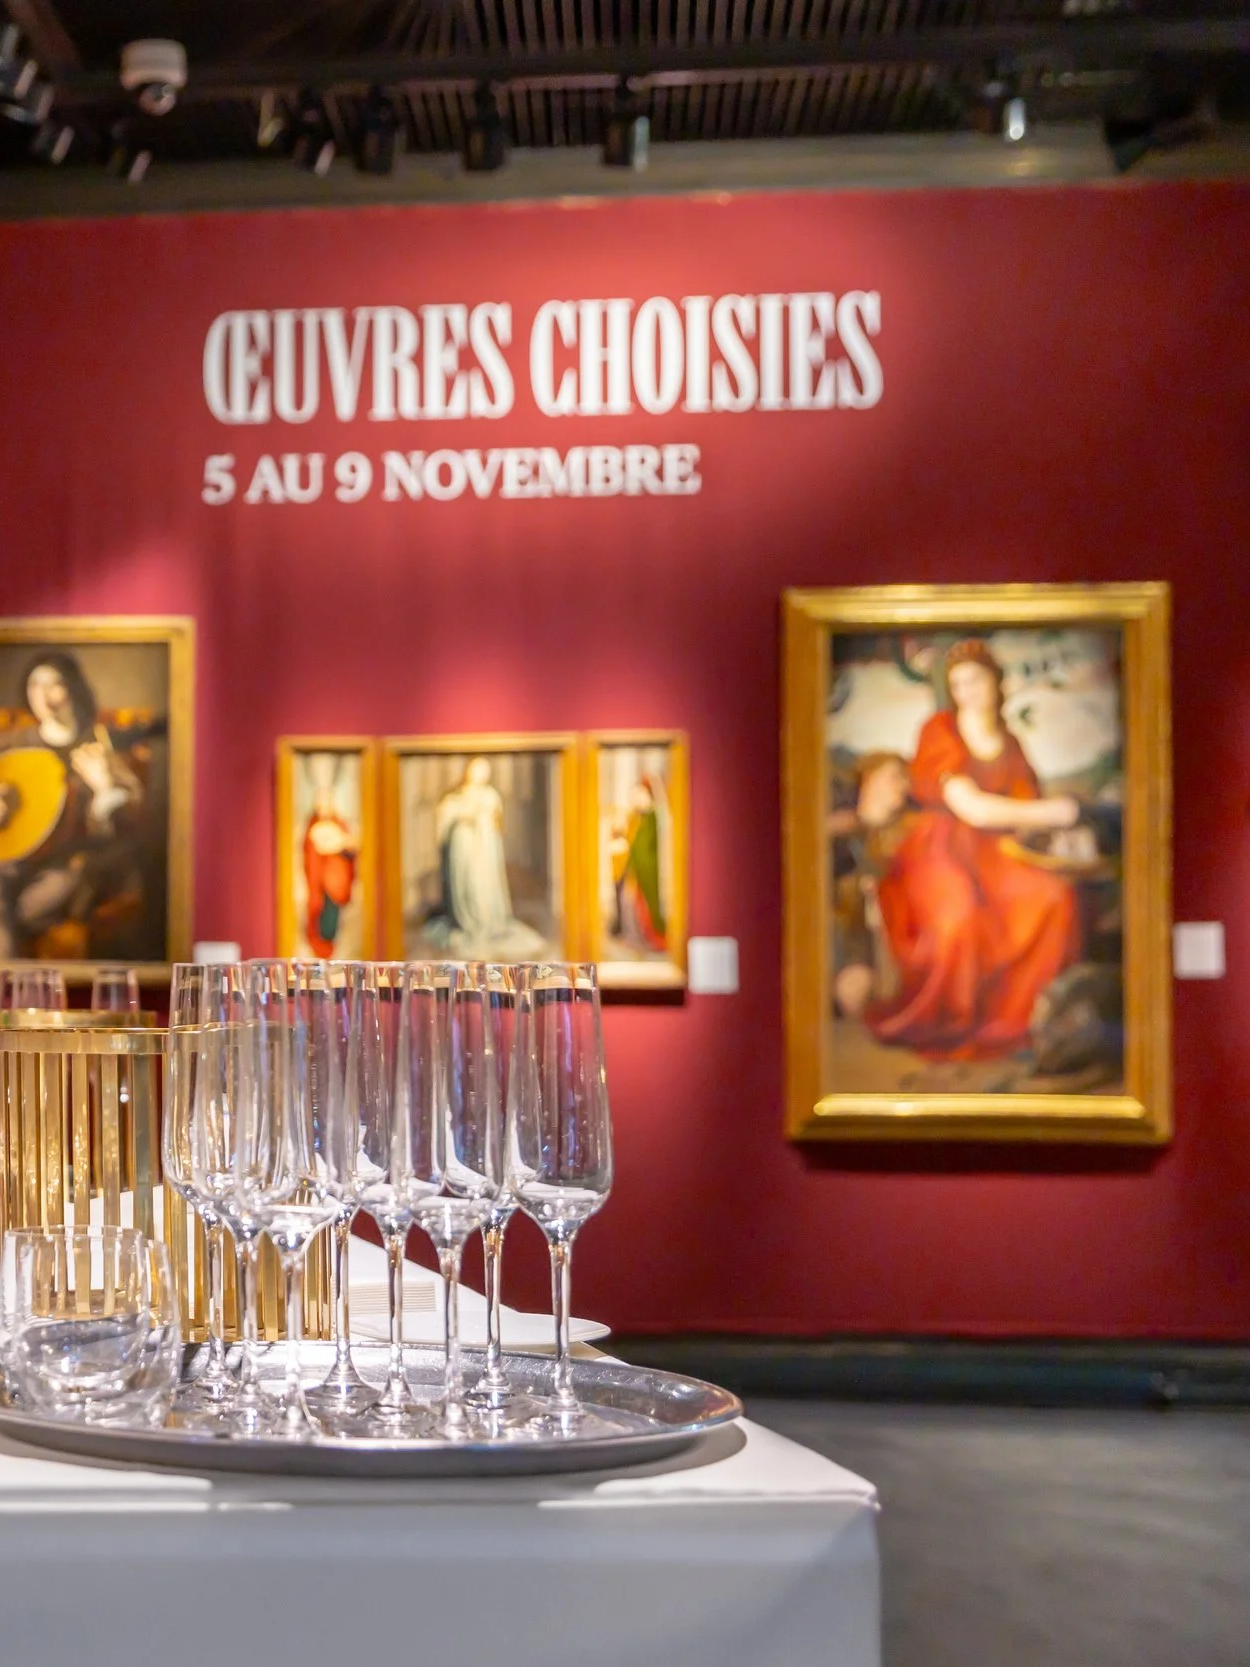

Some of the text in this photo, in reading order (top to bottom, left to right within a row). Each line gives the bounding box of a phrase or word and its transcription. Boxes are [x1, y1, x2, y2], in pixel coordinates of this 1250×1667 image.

[203, 290, 883, 424] ŒUVRES CHOISIES
[203, 443, 702, 504] 5 AU 9 NOVEMBRE
